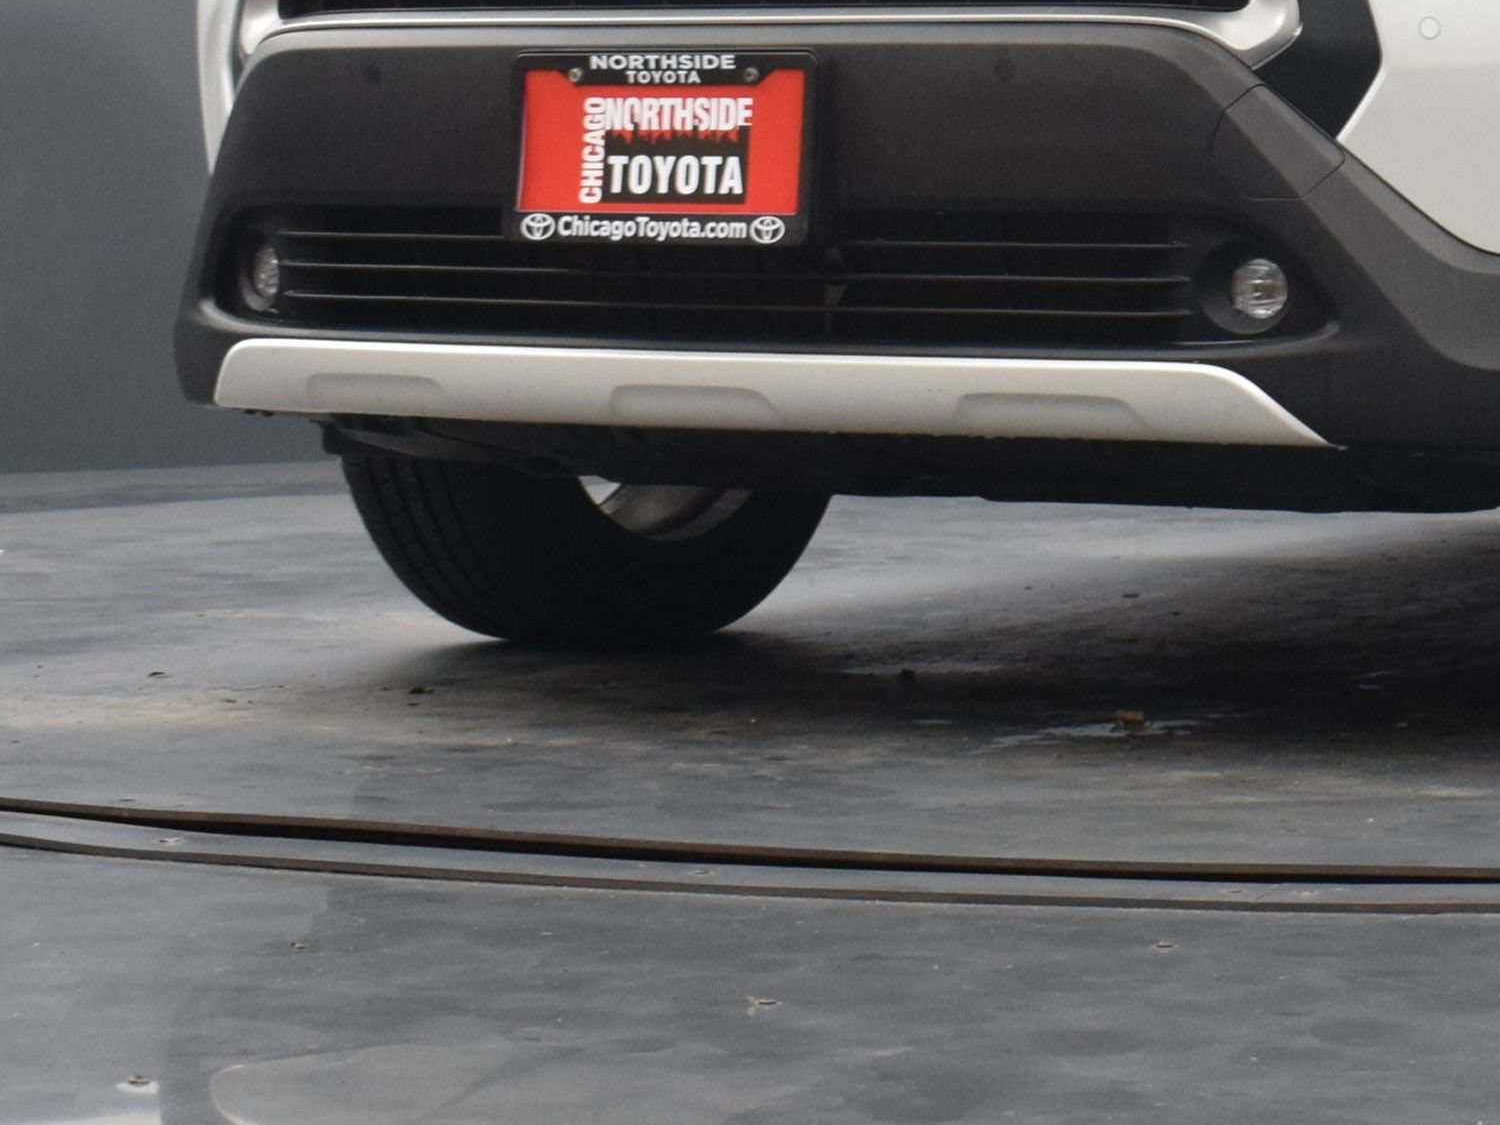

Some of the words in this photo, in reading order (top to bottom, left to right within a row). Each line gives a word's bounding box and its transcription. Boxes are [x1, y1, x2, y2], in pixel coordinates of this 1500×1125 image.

[589, 54, 736, 70] NORTHSIDE
[626, 71, 701, 84] TOYOTA
[604, 97, 752, 131] NORTHSIDE
[579, 96, 605, 204] CHICAGO
[608, 155, 743, 194] TOYOTA
[558, 215, 747, 241] ChicagoToyota.com
